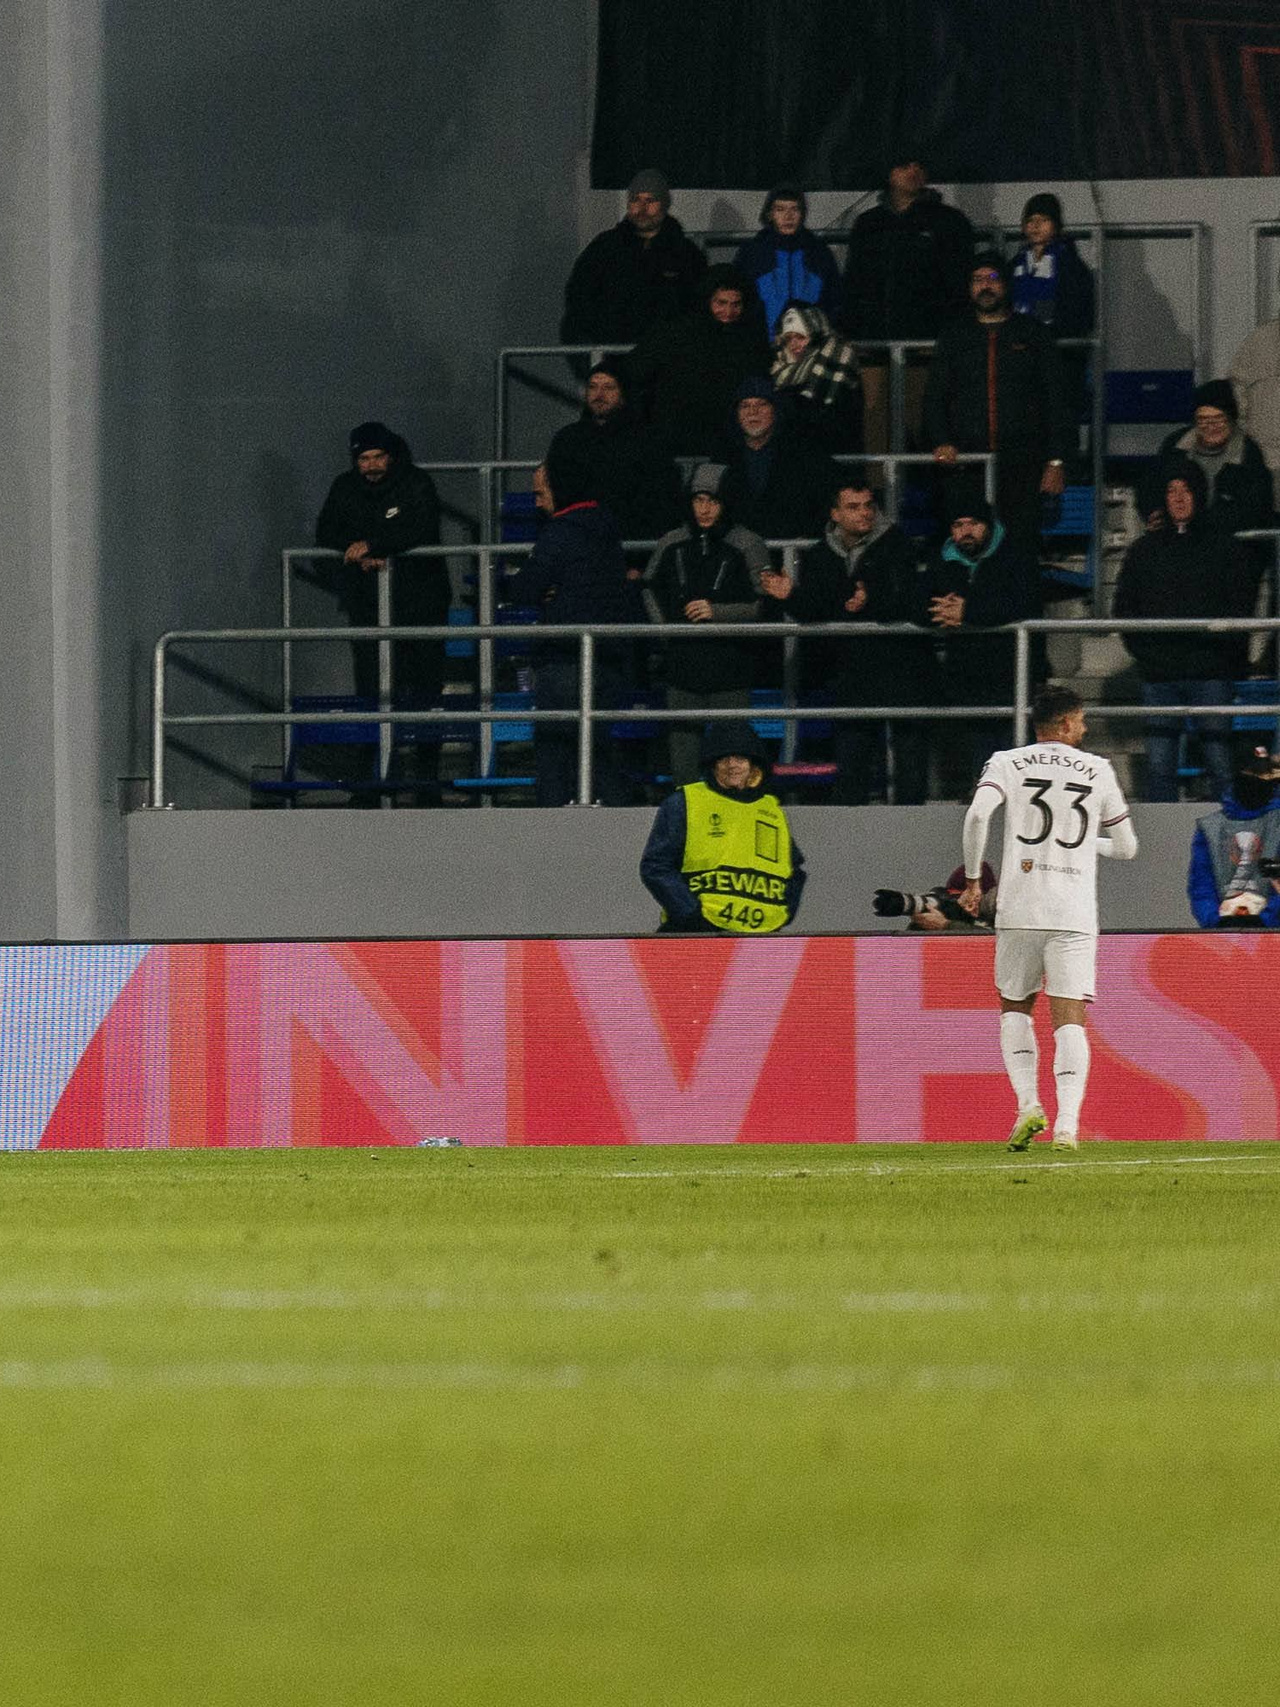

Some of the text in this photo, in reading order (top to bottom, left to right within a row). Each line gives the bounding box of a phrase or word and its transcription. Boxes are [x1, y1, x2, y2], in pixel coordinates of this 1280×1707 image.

[1012, 753, 1098, 782] EMERSON
[1016, 777, 1093, 849] 33
[688, 870, 786, 900] STEWAR
[718, 902, 764, 929] 449
